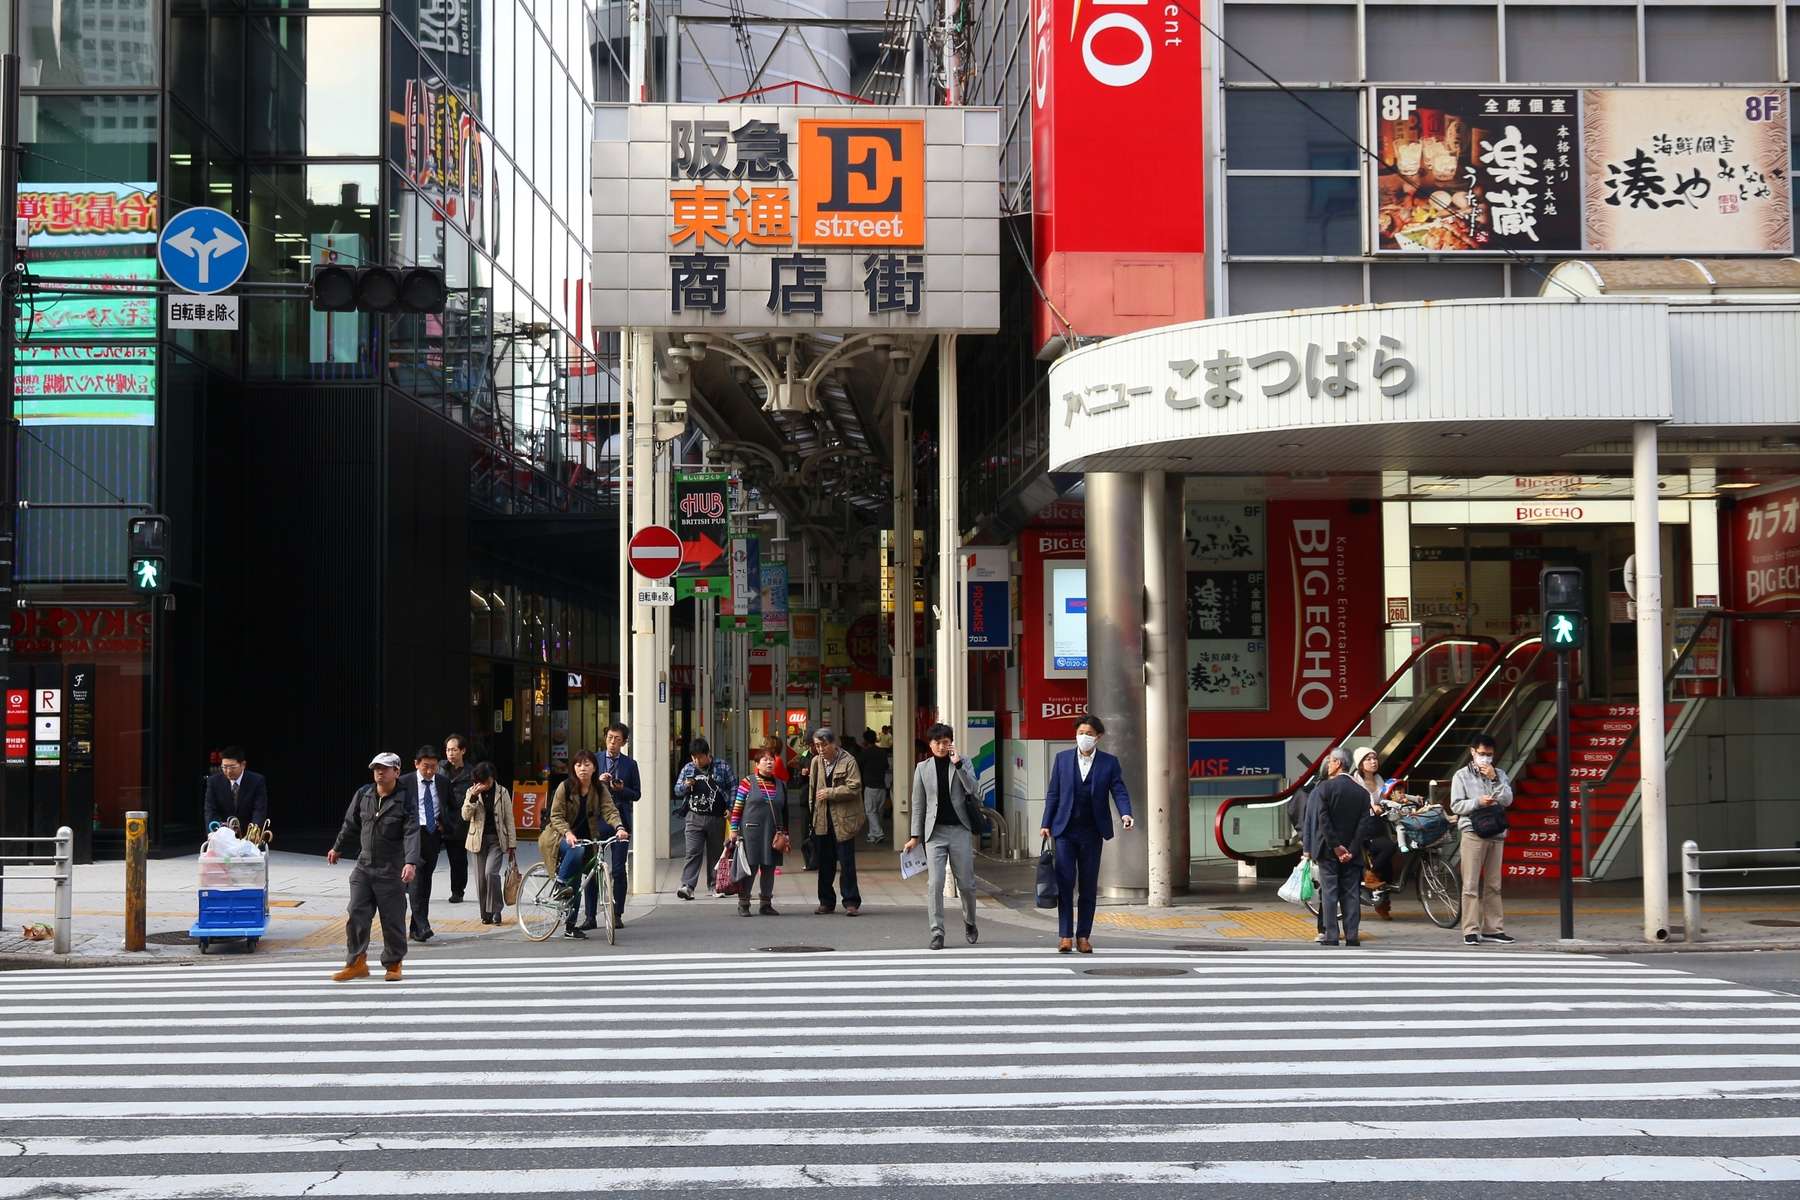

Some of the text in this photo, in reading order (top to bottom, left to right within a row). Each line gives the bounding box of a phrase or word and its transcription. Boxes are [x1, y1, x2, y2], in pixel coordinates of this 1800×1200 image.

[1382, 94, 1417, 121] 8F
[1484, 98, 1567, 113] 全席個室
[1745, 96, 1780, 121] 8F
[669, 118, 795, 181] 阪急
[1652, 133, 1736, 157] 海鮮個室
[816, 127, 903, 213] E
[1479, 124, 1540, 243] 楽蔵
[1542, 158, 1558, 216] 海と大地
[668, 184, 793, 248] 東通
[815, 213, 904, 239] street
[668, 252, 926, 315] 商店街
[171, 302, 236, 322] 自転車を除く
[1164, 334, 1417, 411] こまつばら
[680, 492, 725, 518] HUB
[1516, 506, 1584, 521] BIG ECHO
[681, 517, 726, 526] BRITISH PUB
[1039, 537, 1069, 553] BIG
[1247, 572, 1264, 584] 8F
[1746, 568, 1777, 604] BIG
[1193, 577, 1223, 635] 楽蔵
[1293, 519, 1334, 721] BIG ECHO
[1336, 536, 1349, 701] Karaoke Entertainment
[1247, 641, 1264, 653] 8F
[42, 691, 55, 709] R
[1041, 702, 1073, 719] BIG
[789, 713, 806, 723] au
[1589, 737, 1627, 746] カラオケ
[1569, 768, 1609, 779] カラオケ
[1529, 832, 1560, 842] カラオ
[1508, 865, 1547, 876] カラオケ
